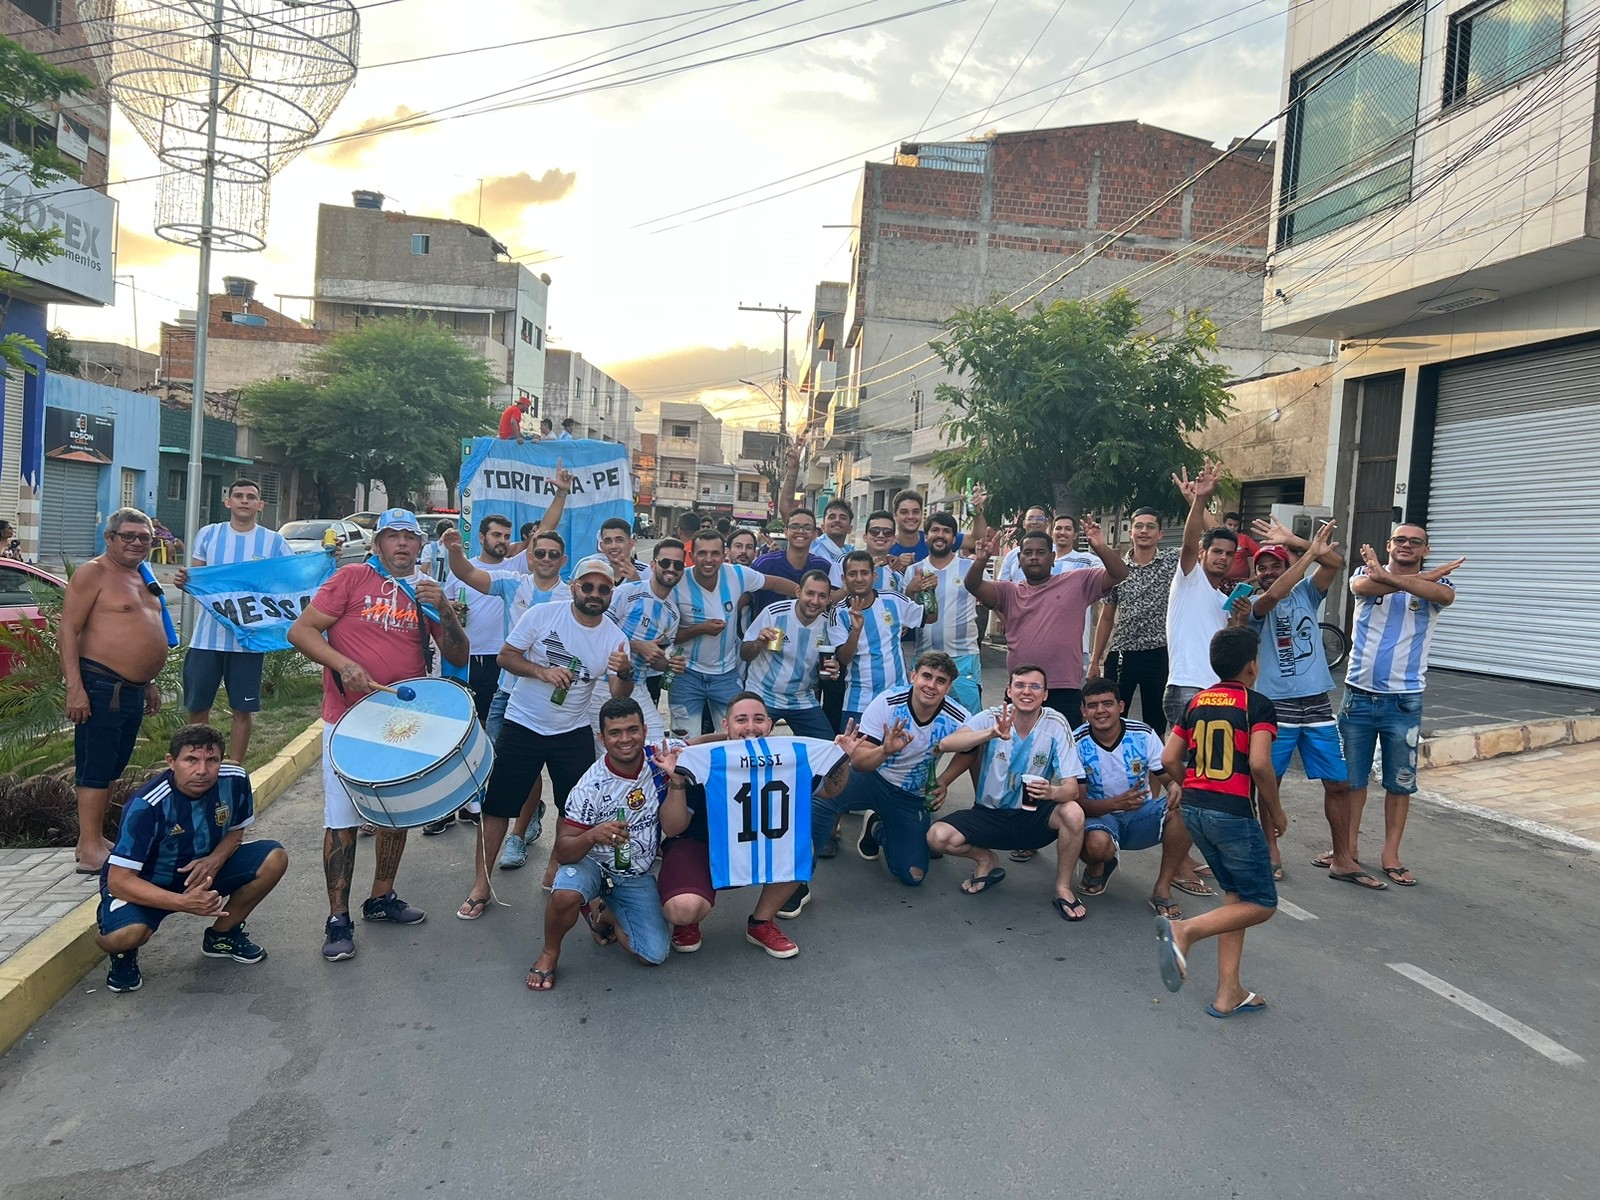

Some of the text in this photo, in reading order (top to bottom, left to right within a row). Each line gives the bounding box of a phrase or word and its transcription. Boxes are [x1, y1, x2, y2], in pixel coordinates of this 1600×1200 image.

[70, 431, 94, 441] EDSON
[1395, 482, 1407, 495] 52
[641, 616, 651, 628] 10
[1276, 615, 1292, 637] PAPEL
[1278, 647, 1295, 668] CASA
[1280, 667, 1295, 678] LA
[1196, 697, 1237, 706] NASSAU
[1192, 719, 1234, 780] 10
[740, 753, 783, 768] MESSI
[733, 780, 790, 843] 10
